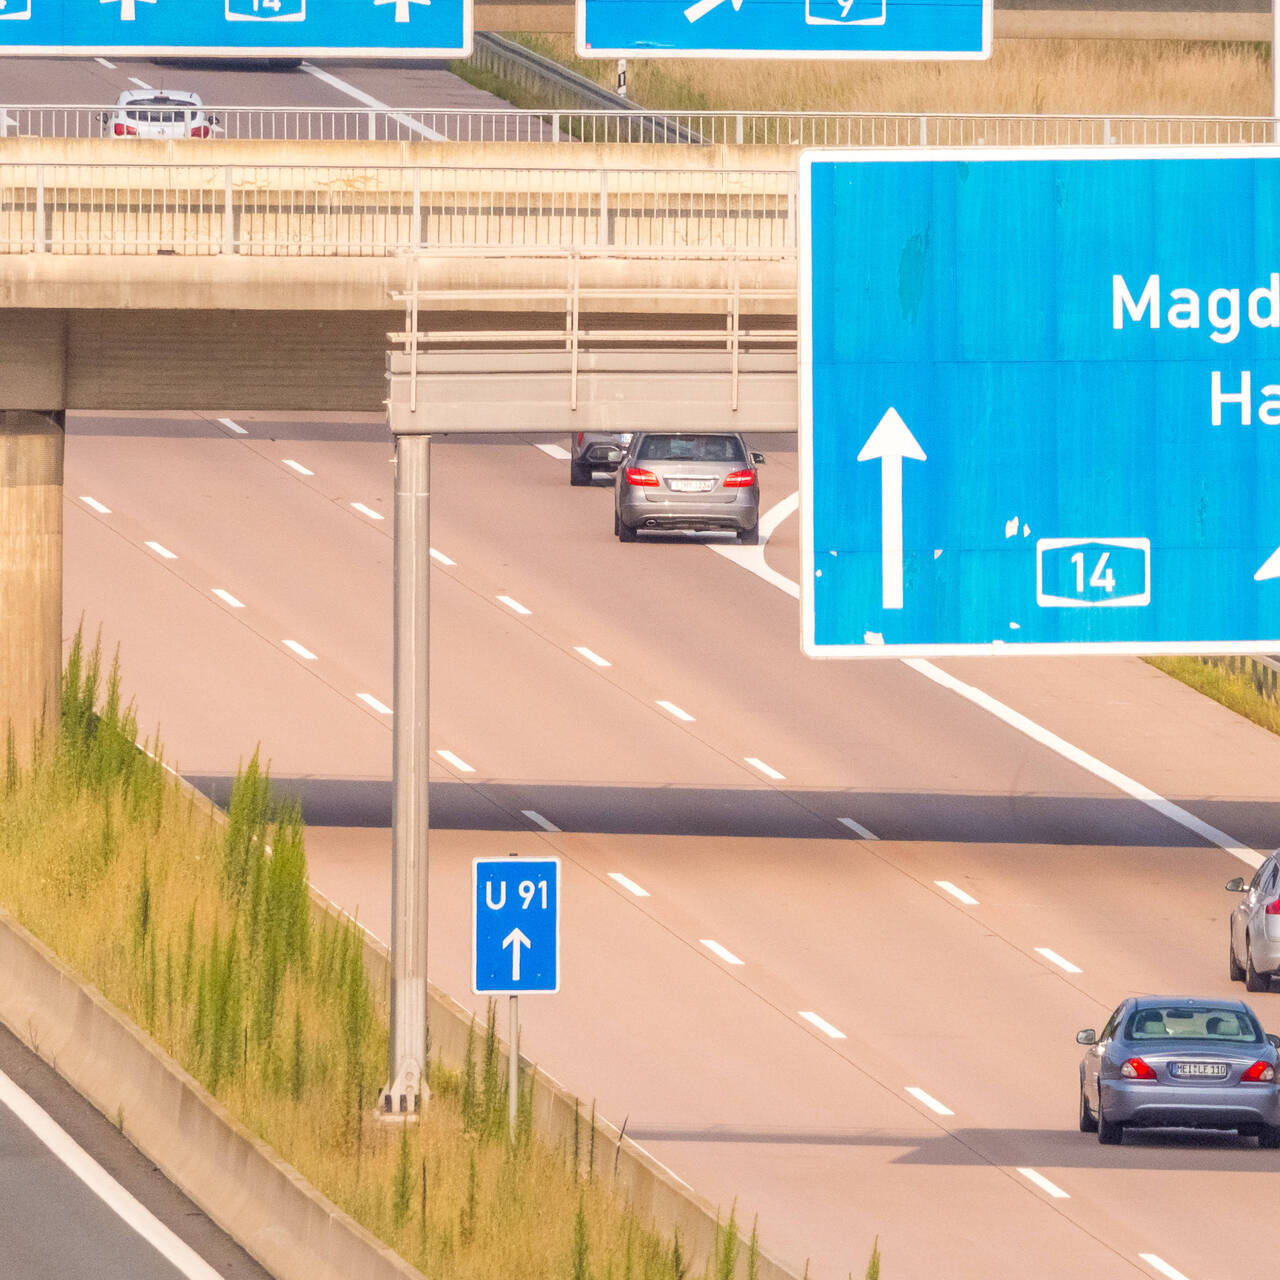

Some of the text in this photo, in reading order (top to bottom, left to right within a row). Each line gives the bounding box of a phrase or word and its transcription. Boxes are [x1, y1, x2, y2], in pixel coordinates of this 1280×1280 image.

[1071, 551, 1116, 593] 14
[485, 880, 548, 911] U 91
[1177, 1064, 1192, 1074] MEI
